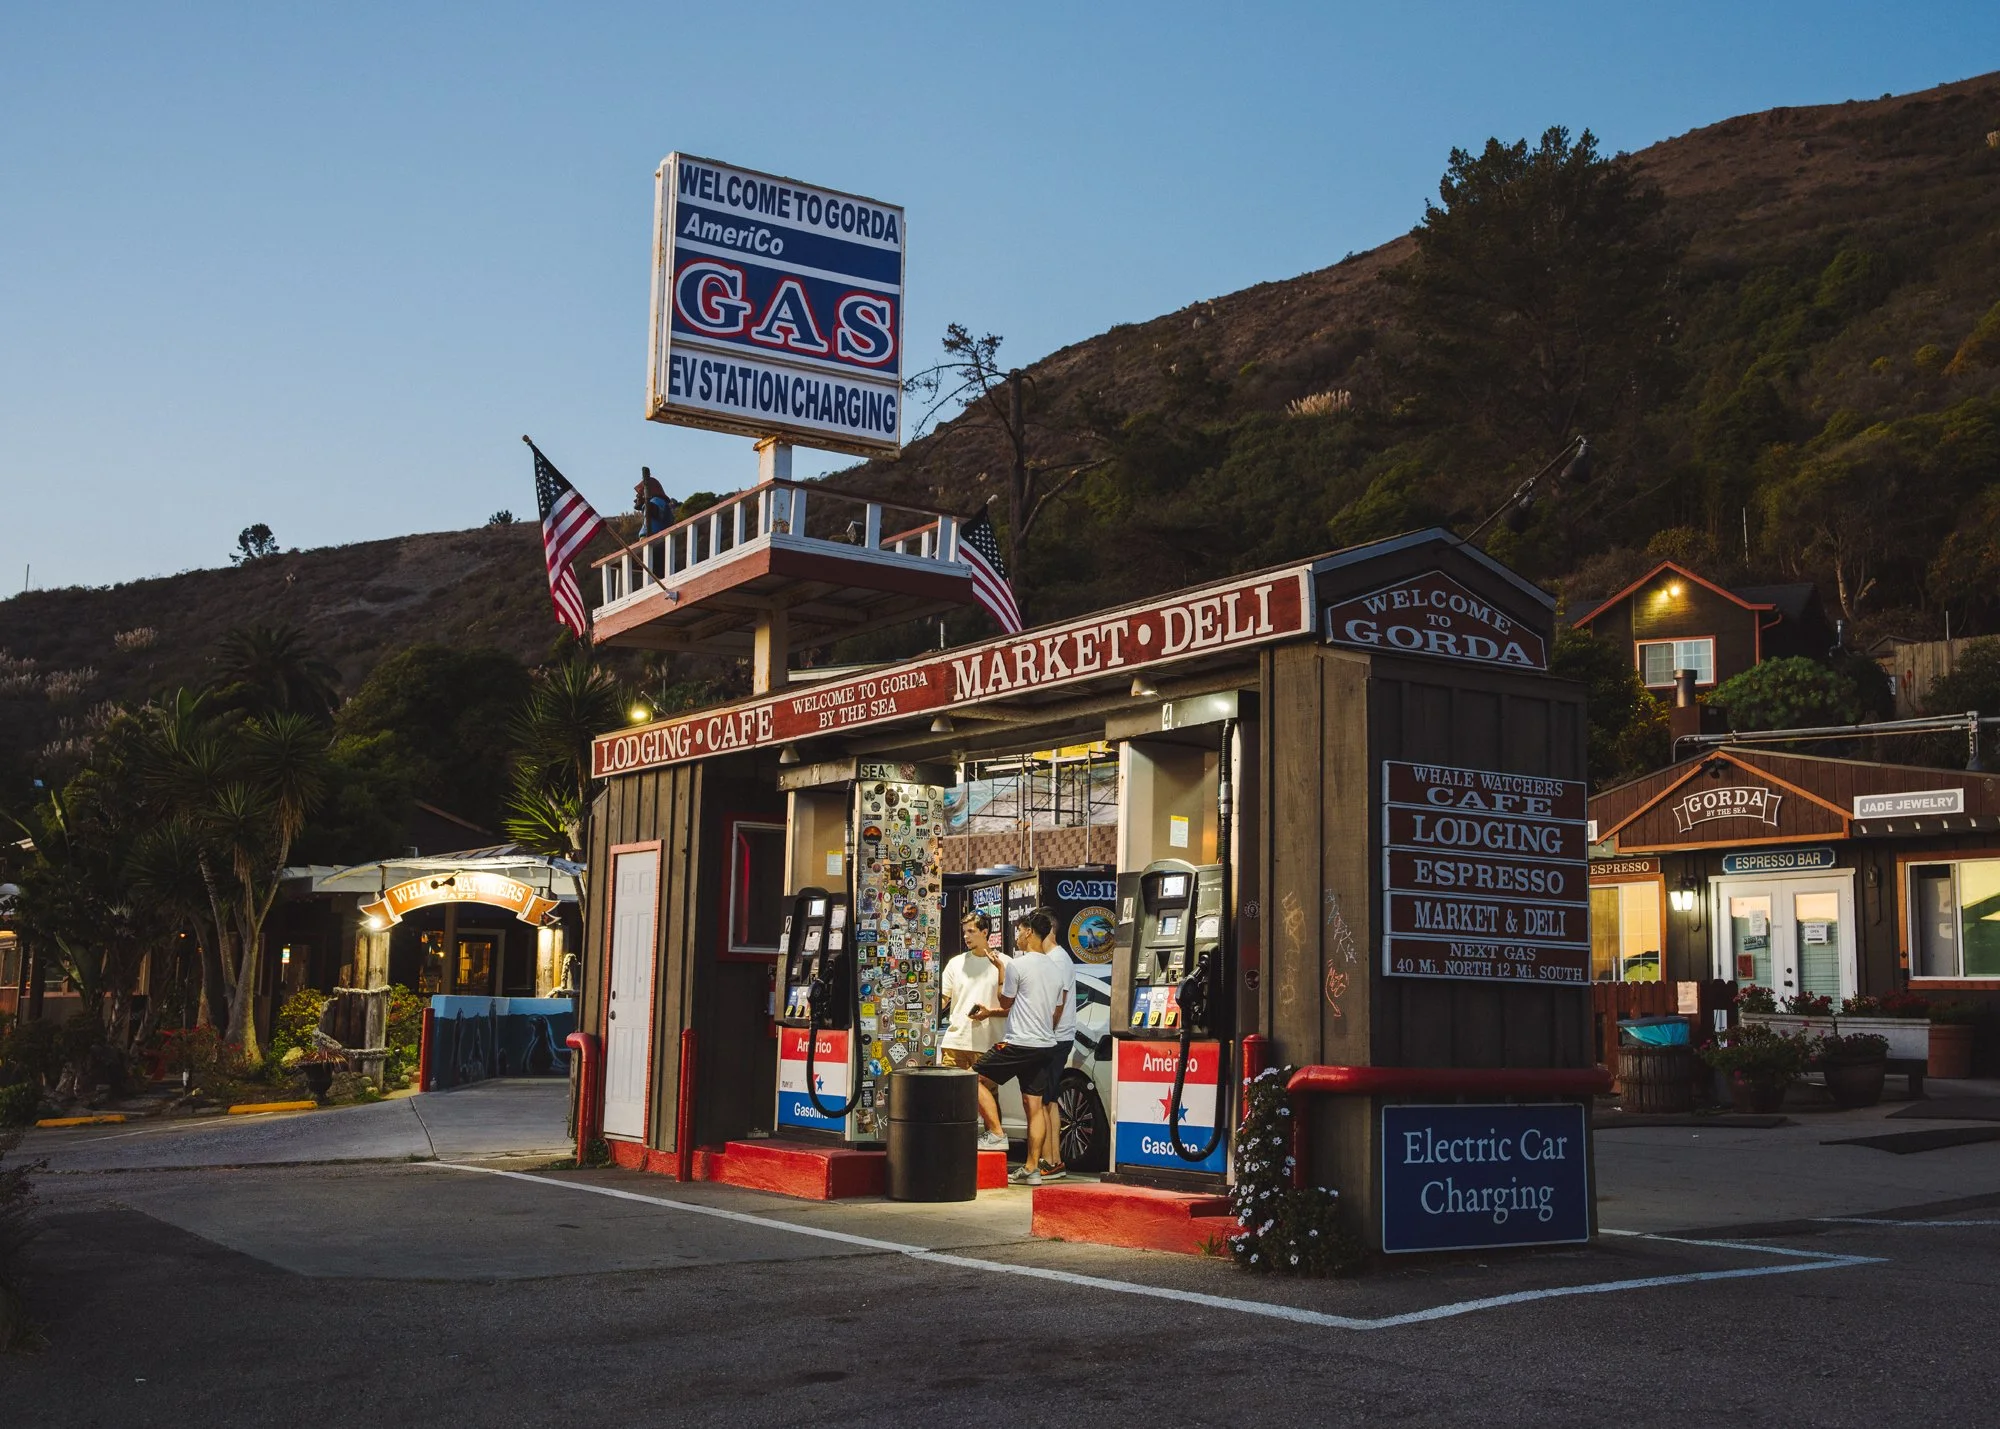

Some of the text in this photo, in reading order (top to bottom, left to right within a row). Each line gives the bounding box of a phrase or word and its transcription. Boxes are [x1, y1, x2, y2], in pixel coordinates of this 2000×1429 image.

[678, 162, 899, 244] WELCOME TO GORDA
[683, 212, 784, 255] AmeriCo
[674, 260, 896, 364] GAS
[668, 355, 897, 434] EV STATION CHARGING
[1363, 589, 1512, 635] WELCOME
[1426, 613, 1451, 628] TO
[952, 584, 1274, 702] MARKET DELI
[1345, 618, 1534, 666] GORDA
[792, 671, 928, 715] WELCOME TO GORDA
[819, 697, 897, 728] BY THE SEA
[602, 705, 774, 773] LODGING CAFE
[1413, 766, 1564, 797] WHALE WATCHERS
[1426, 787, 1552, 816] CAFE
[1688, 790, 1763, 812] GORDA
[1706, 809, 1715, 817] BY
[1717, 808, 1731, 816] THE
[1862, 797, 1954, 813] JADE JEWELRY
[1412, 815, 1564, 853] LODGING
[1414, 859, 1564, 894] ESPRESSO
[1590, 861, 1650, 875] ESPRESSO
[1735, 853, 1821, 869] ESPRESSO BAR
[785, 917, 791, 934] 2
[1414, 901, 1566, 936] MARKET & DELI
[1396, 958, 1583, 981] 40 Mi. NORTH 12 Mi. SOUTH
[1450, 943, 1536, 961] NEXT GAS
[797, 1037, 832, 1054] Amrico
[1403, 1127, 1568, 1164] Electric Car
[1420, 1176, 1554, 1224] Charging
